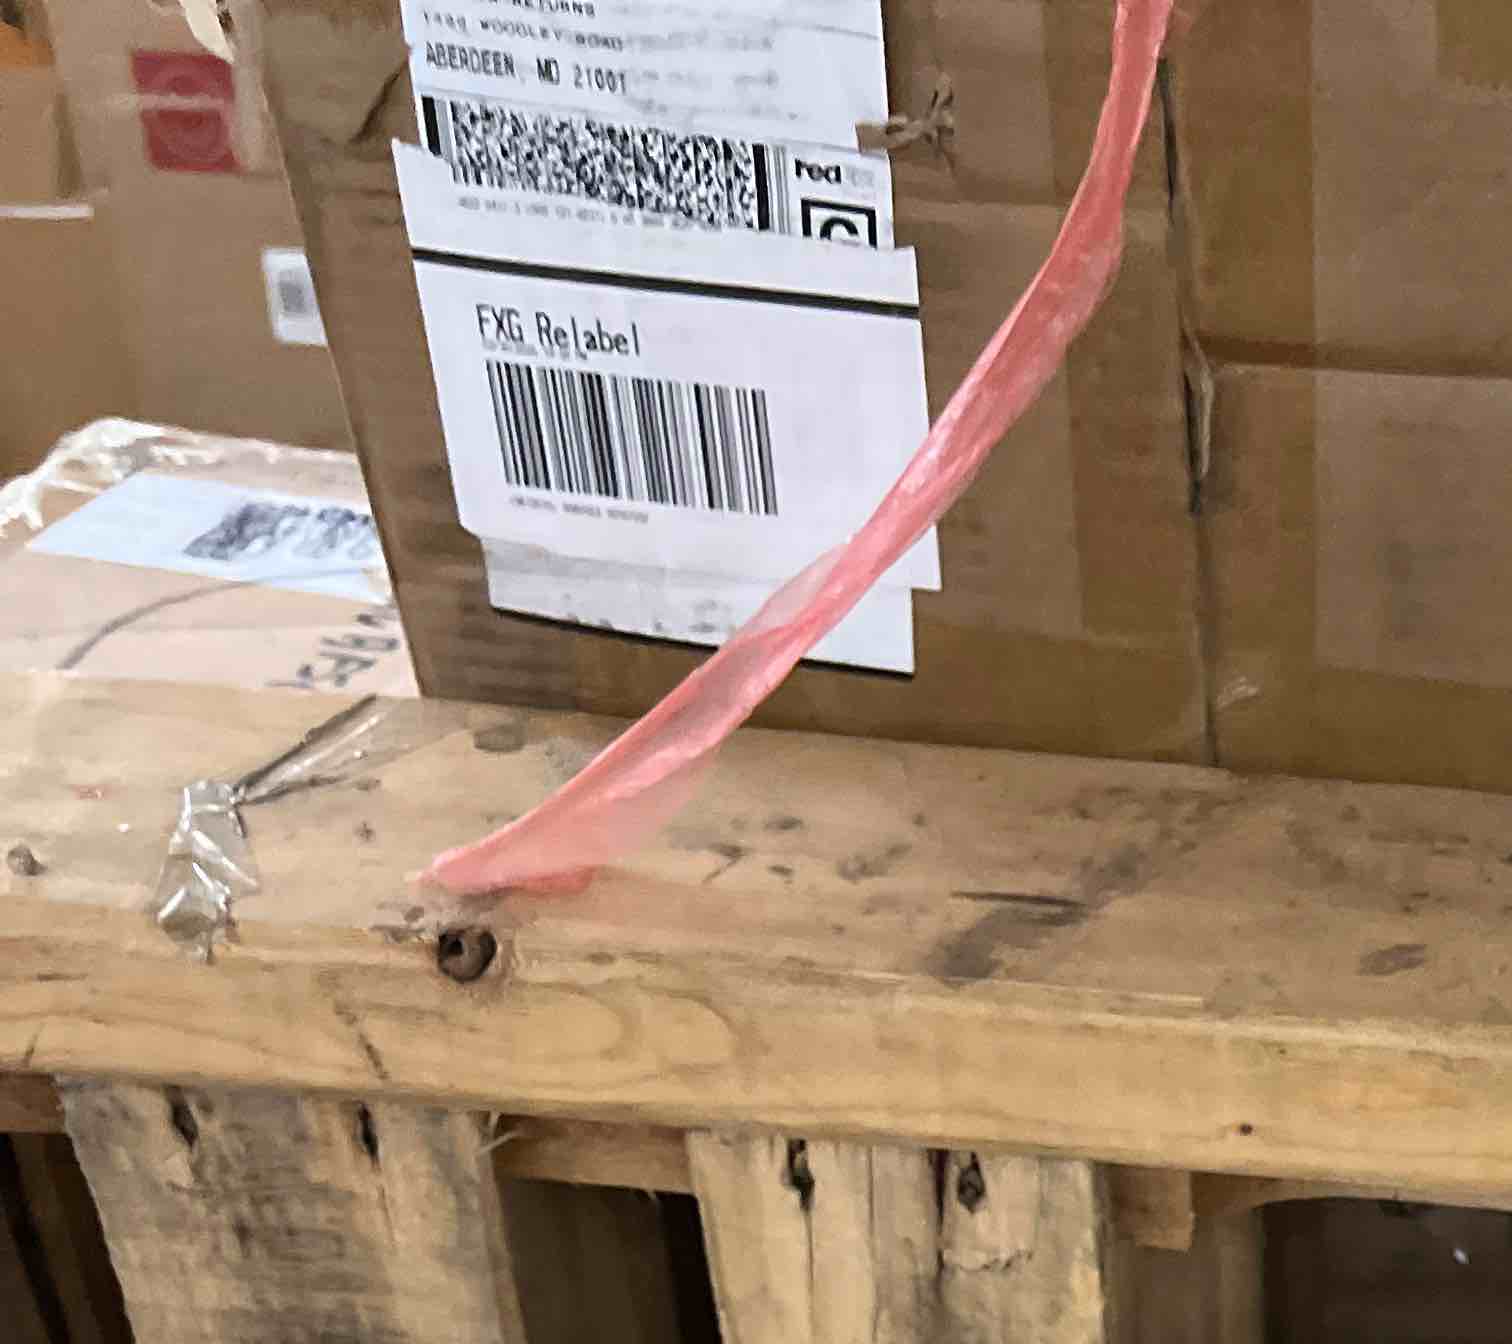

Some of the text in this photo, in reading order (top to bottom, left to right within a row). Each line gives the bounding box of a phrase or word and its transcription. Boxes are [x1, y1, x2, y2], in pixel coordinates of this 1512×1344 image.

[536, 57, 562, 86] MD
[573, 64, 627, 96] 21001
[476, 303, 524, 345] FXG
